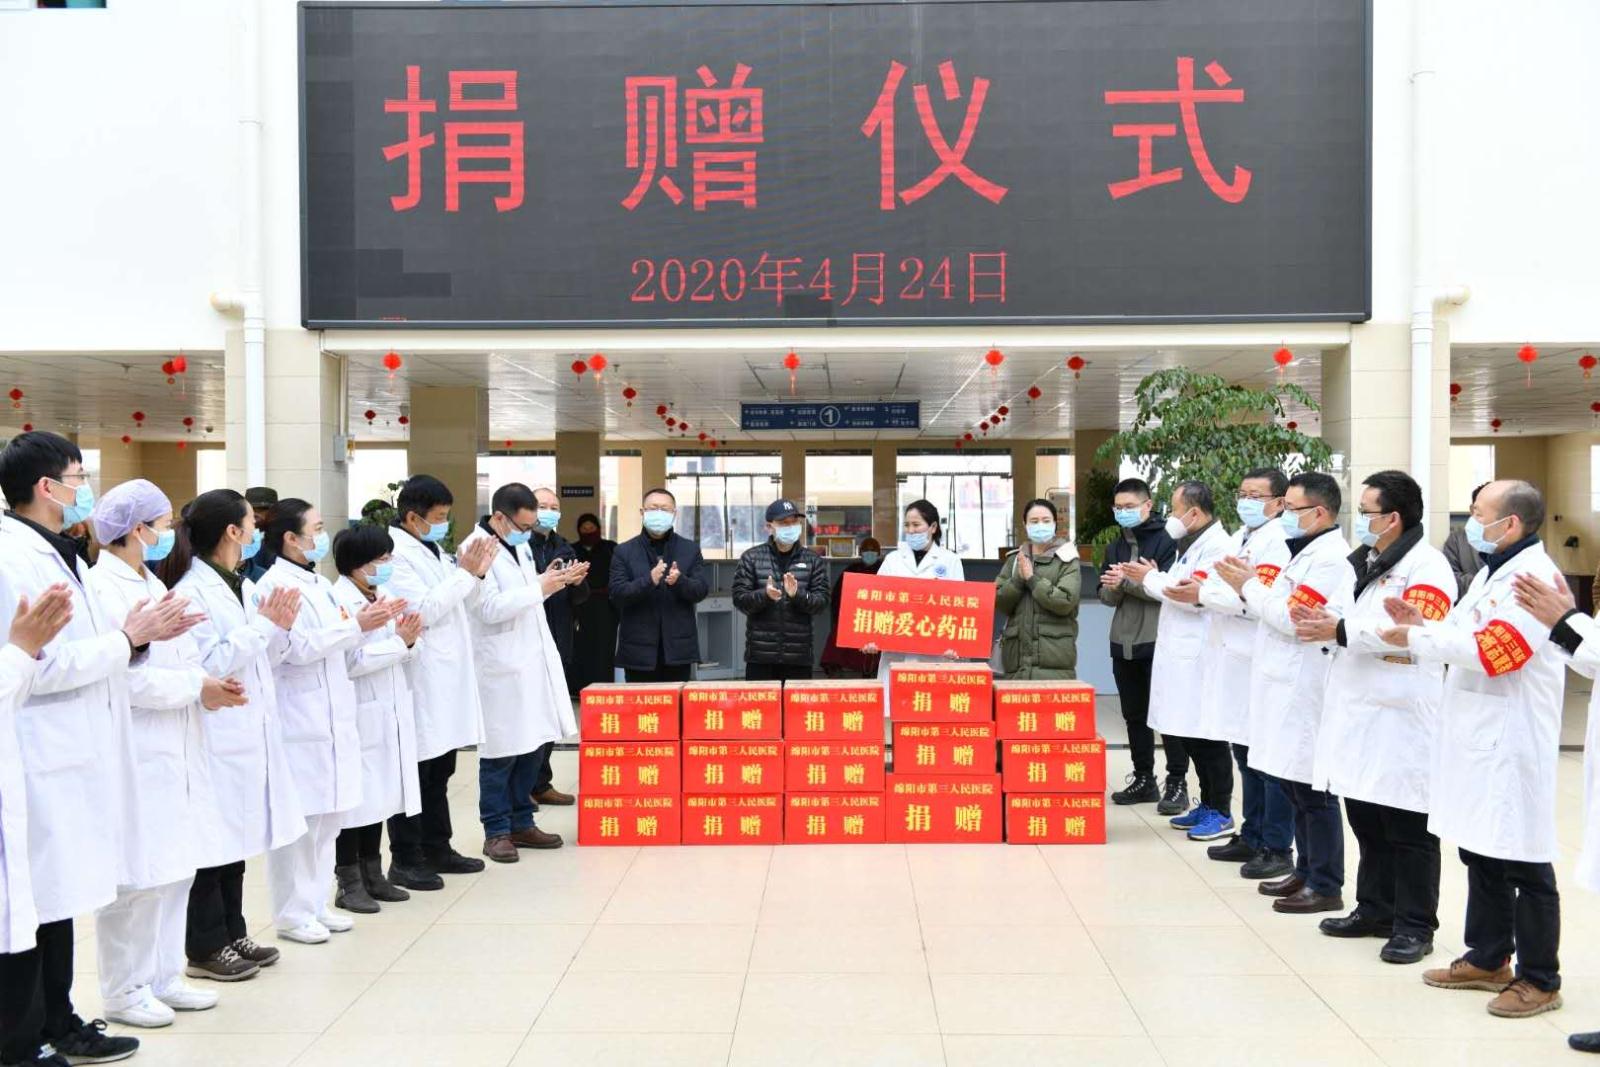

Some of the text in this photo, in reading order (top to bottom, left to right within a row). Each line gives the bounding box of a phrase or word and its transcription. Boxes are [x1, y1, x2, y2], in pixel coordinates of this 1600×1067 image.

[384, 58, 1252, 211] 捐赠仪式
[631, 252, 1006, 304] 2020年4月24日
[856, 588, 980, 609] 绵阳市第三人民医院
[853, 608, 979, 641] 捐赠爱心药品
[897, 672, 986, 685] 绵阳市第三人民医院
[586, 695, 673, 705] 绵阳市第三人民医院
[688, 691, 778, 702] 绵阳市第三人民医院
[790, 692, 877, 703] 绵阳市第三人民医院
[912, 691, 970, 713] 捐赠
[1002, 693, 1090, 704] 绵阳市第三人民医院
[600, 713, 659, 733] 捐赠
[704, 709, 762, 730] 捐赠
[805, 711, 864, 731] 捐赠
[1017, 712, 1076, 732] 捐赠
[900, 727, 990, 738] 绵阳市第三人民医院
[585, 747, 674, 757] 绵阳市第三人民医院
[688, 746, 777, 756] 绵阳市第三人民医院
[791, 746, 879, 757] 绵阳市第三人民医院
[916, 744, 974, 765] 捐赠
[1011, 744, 1101, 754] 绵阳市第三人民医院
[601, 765, 659, 785] 捐赠
[704, 764, 762, 784] 捐赠
[807, 764, 864, 784] 捐赠
[1028, 762, 1085, 782] 捐赠
[894, 783, 993, 794] 绵阳市第三人民医院
[584, 797, 673, 808] 绵阳市第三人民医院
[688, 797, 776, 807] 绵阳市第三人民医院
[791, 797, 879, 807] 绵阳市第三人民医院
[1011, 798, 1102, 809] 绵阳市第三人民医院
[600, 816, 657, 836] 捐赠
[704, 815, 761, 835] 捐赠
[807, 815, 864, 835] 捐赠
[905, 804, 982, 831] 捐赠
[1028, 816, 1085, 836] 捐赠
